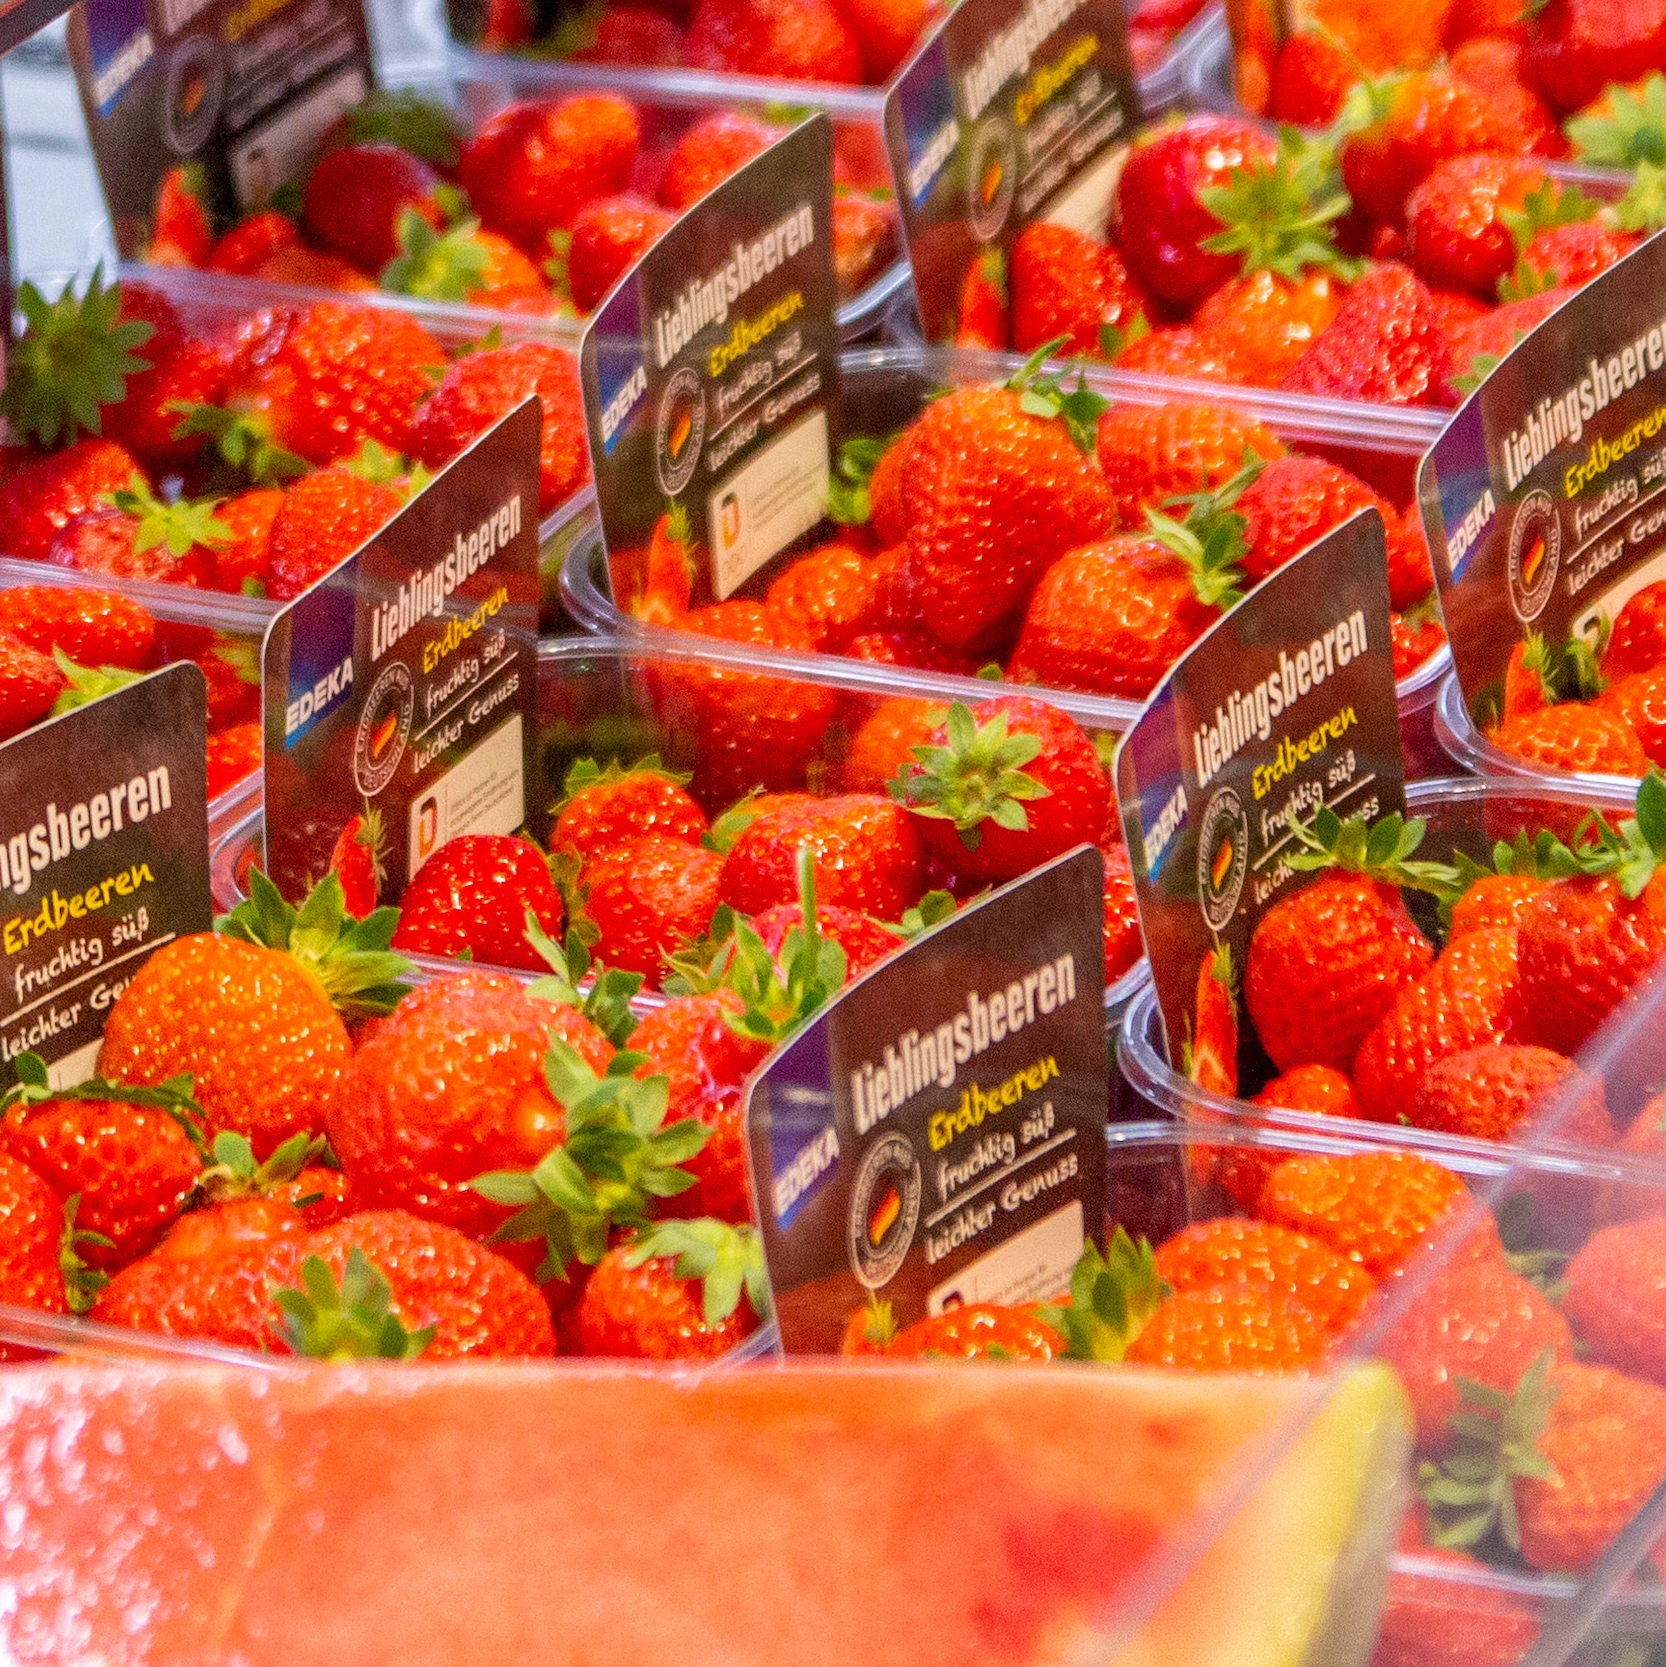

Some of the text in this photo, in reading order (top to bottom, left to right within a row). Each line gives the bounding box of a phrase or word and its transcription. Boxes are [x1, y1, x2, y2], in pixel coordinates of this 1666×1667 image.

[654, 203, 814, 369] Lieblingsbeeren
[600, 365, 648, 443] EDEKA
[1446, 488, 1496, 573] EDEKA
[1573, 477, 1639, 543] fruchtig
[370, 495, 522, 662] Lieblingsbeeren
[1567, 539, 1625, 596] leichter
[423, 585, 509, 675] Erdbeeren
[285, 656, 355, 736] EDEKA
[413, 672, 521, 775] leichter Genuss
[425, 649, 480, 720] fruchtig
[1192, 609, 1368, 789] Lieblingsbeeren
[1251, 701, 1359, 800] Erdbeeren
[1143, 784, 1187, 864] EDEKA
[2, 862, 155, 956] Erdbeeren
[13, 935, 104, 1004] fruchtig
[111, 906, 151, 947] süß
[1, 997, 82, 1063] leichter
[850, 952, 1078, 1136] Lieblingsbeeren
[927, 1054, 1061, 1152] Erdbeeren
[775, 1126, 841, 1217] EDEKA
[924, 1152, 1079, 1265] leichter Genuss
[935, 1132, 1018, 1201] fruchtig
